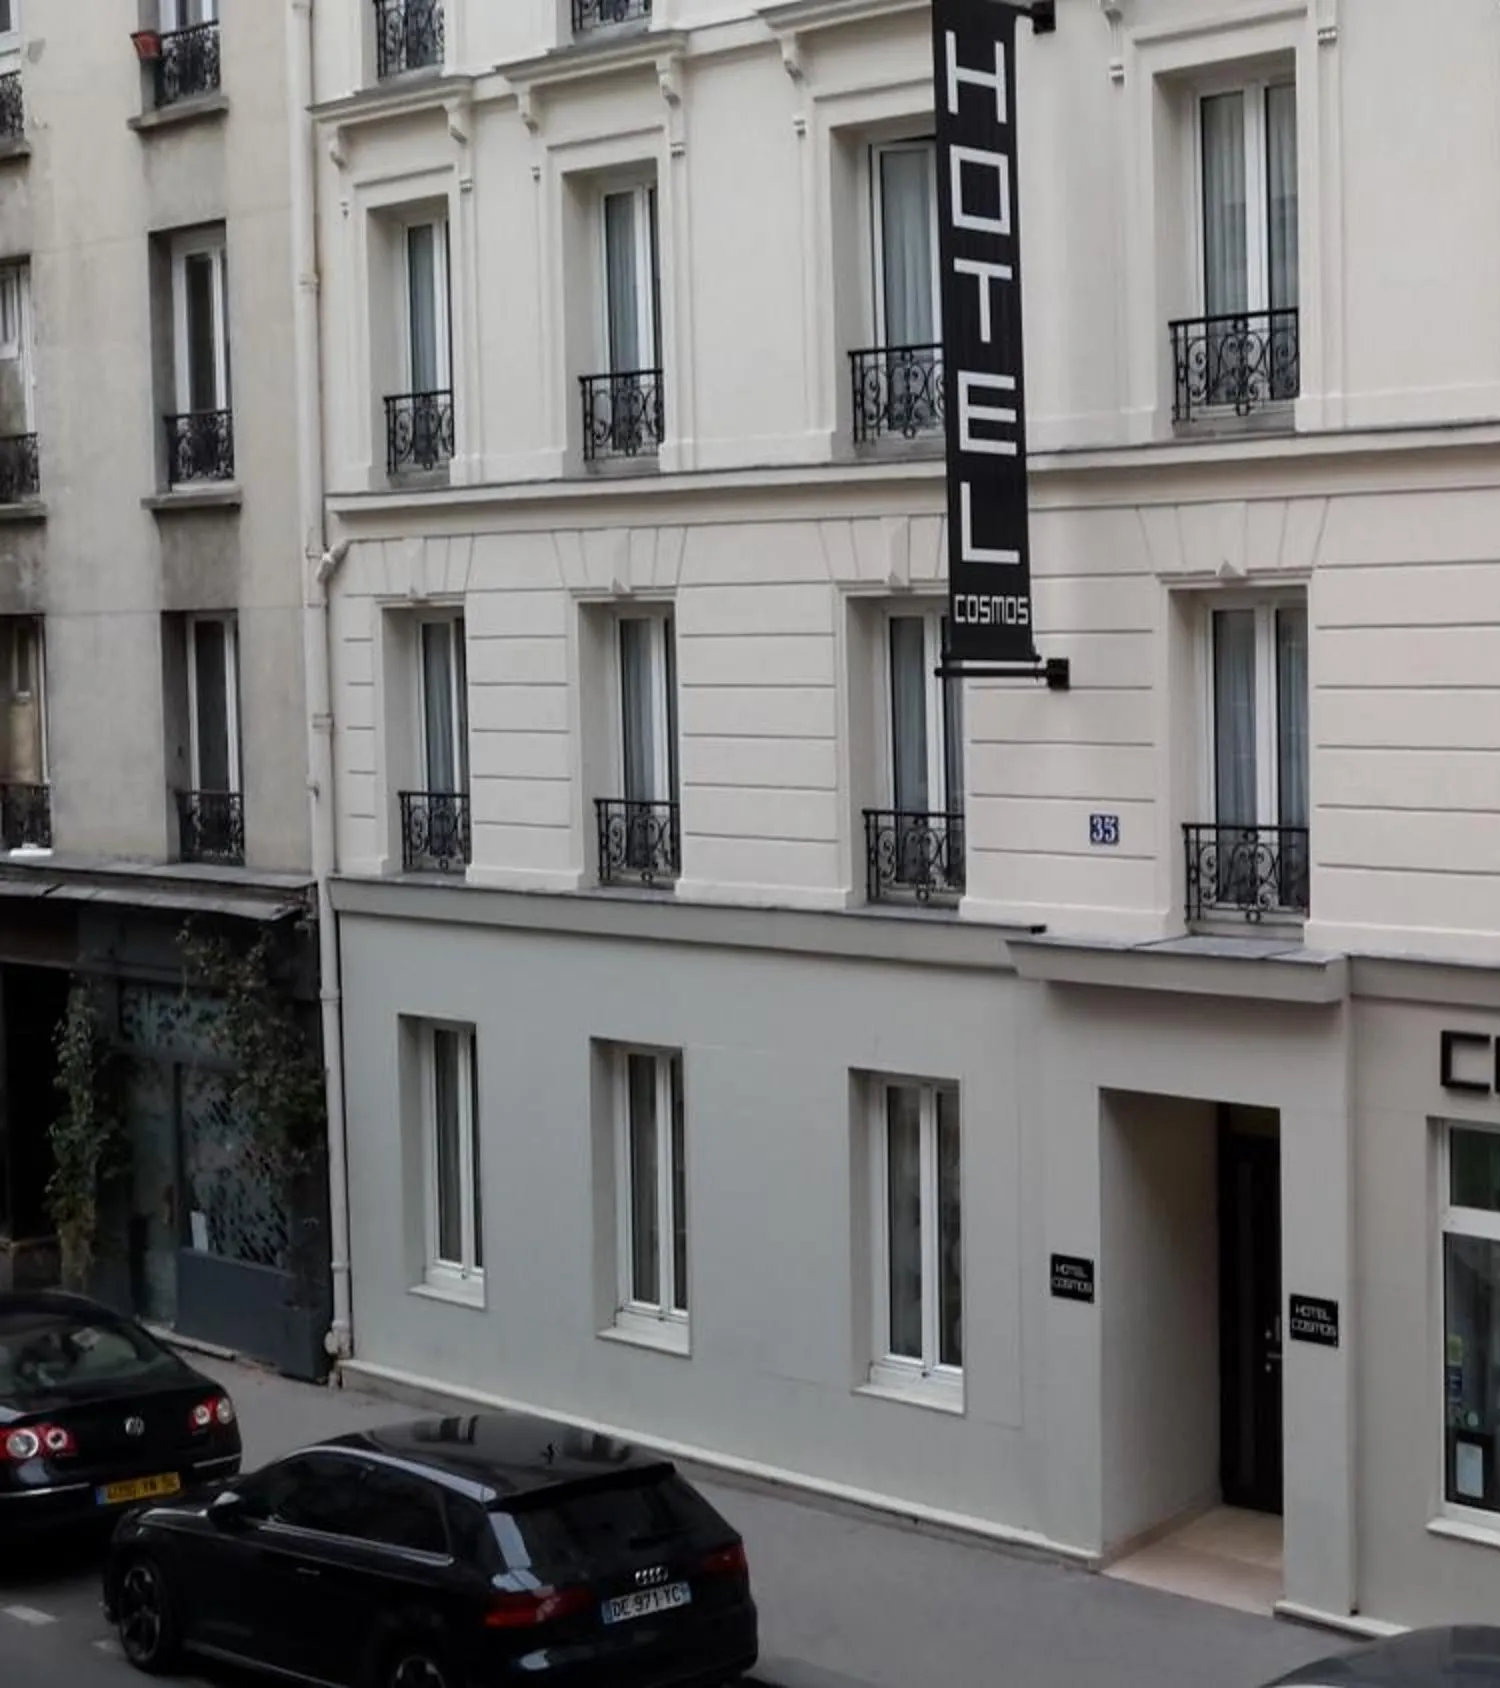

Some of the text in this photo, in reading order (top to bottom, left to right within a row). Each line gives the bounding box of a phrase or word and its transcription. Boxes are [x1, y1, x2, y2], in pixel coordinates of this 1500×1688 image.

[945, 30, 1020, 564] HOTEL
[954, 594, 1029, 625] COSMOS
[1092, 817, 1115, 842] 35
[1055, 1263, 1089, 1279] HOTEL
[1053, 1277, 1093, 1293] COSMOS
[1295, 1303, 1331, 1321] HOTEL
[1291, 1318, 1337, 1337] COSMOS
